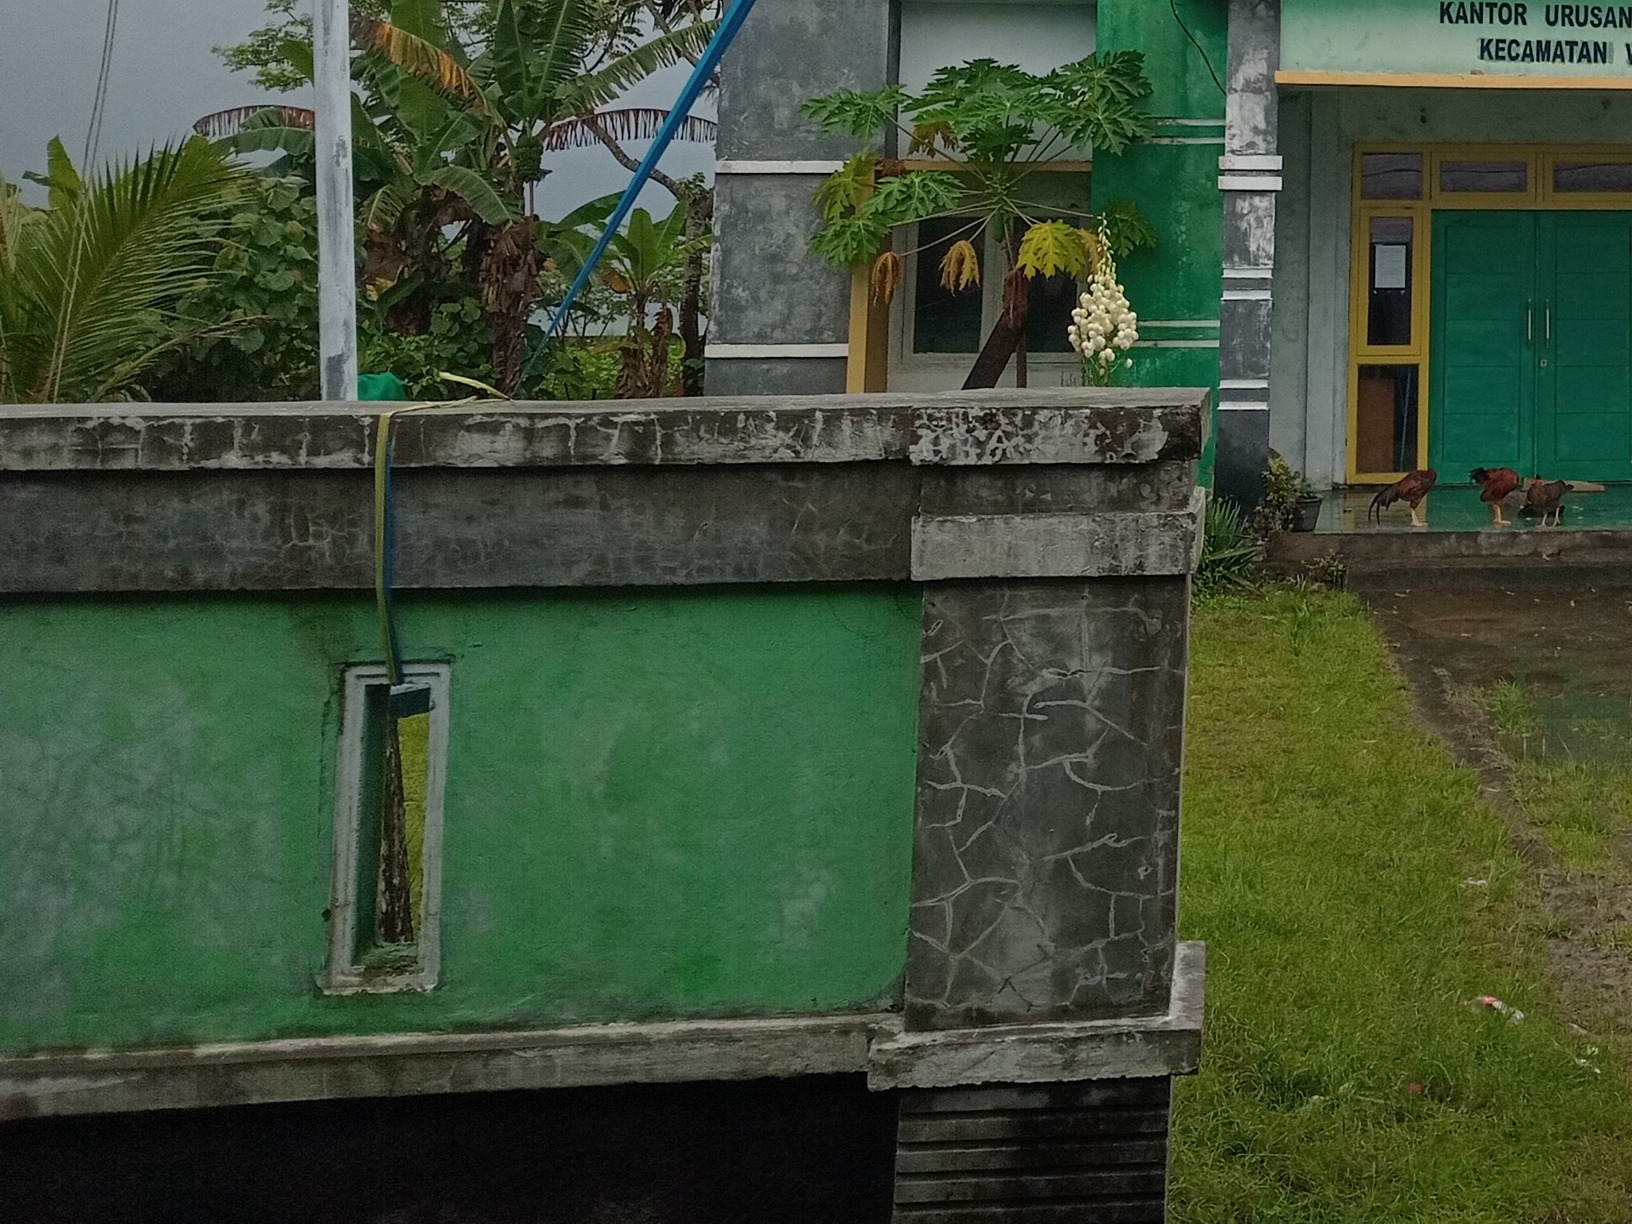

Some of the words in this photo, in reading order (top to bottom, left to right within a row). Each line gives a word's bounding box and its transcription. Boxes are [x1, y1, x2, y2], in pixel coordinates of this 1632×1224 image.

[1439, 1, 1527, 25] KANTOR
[1545, 4, 1632, 29] URUSAN
[1479, 38, 1607, 64] KECAMATAN
